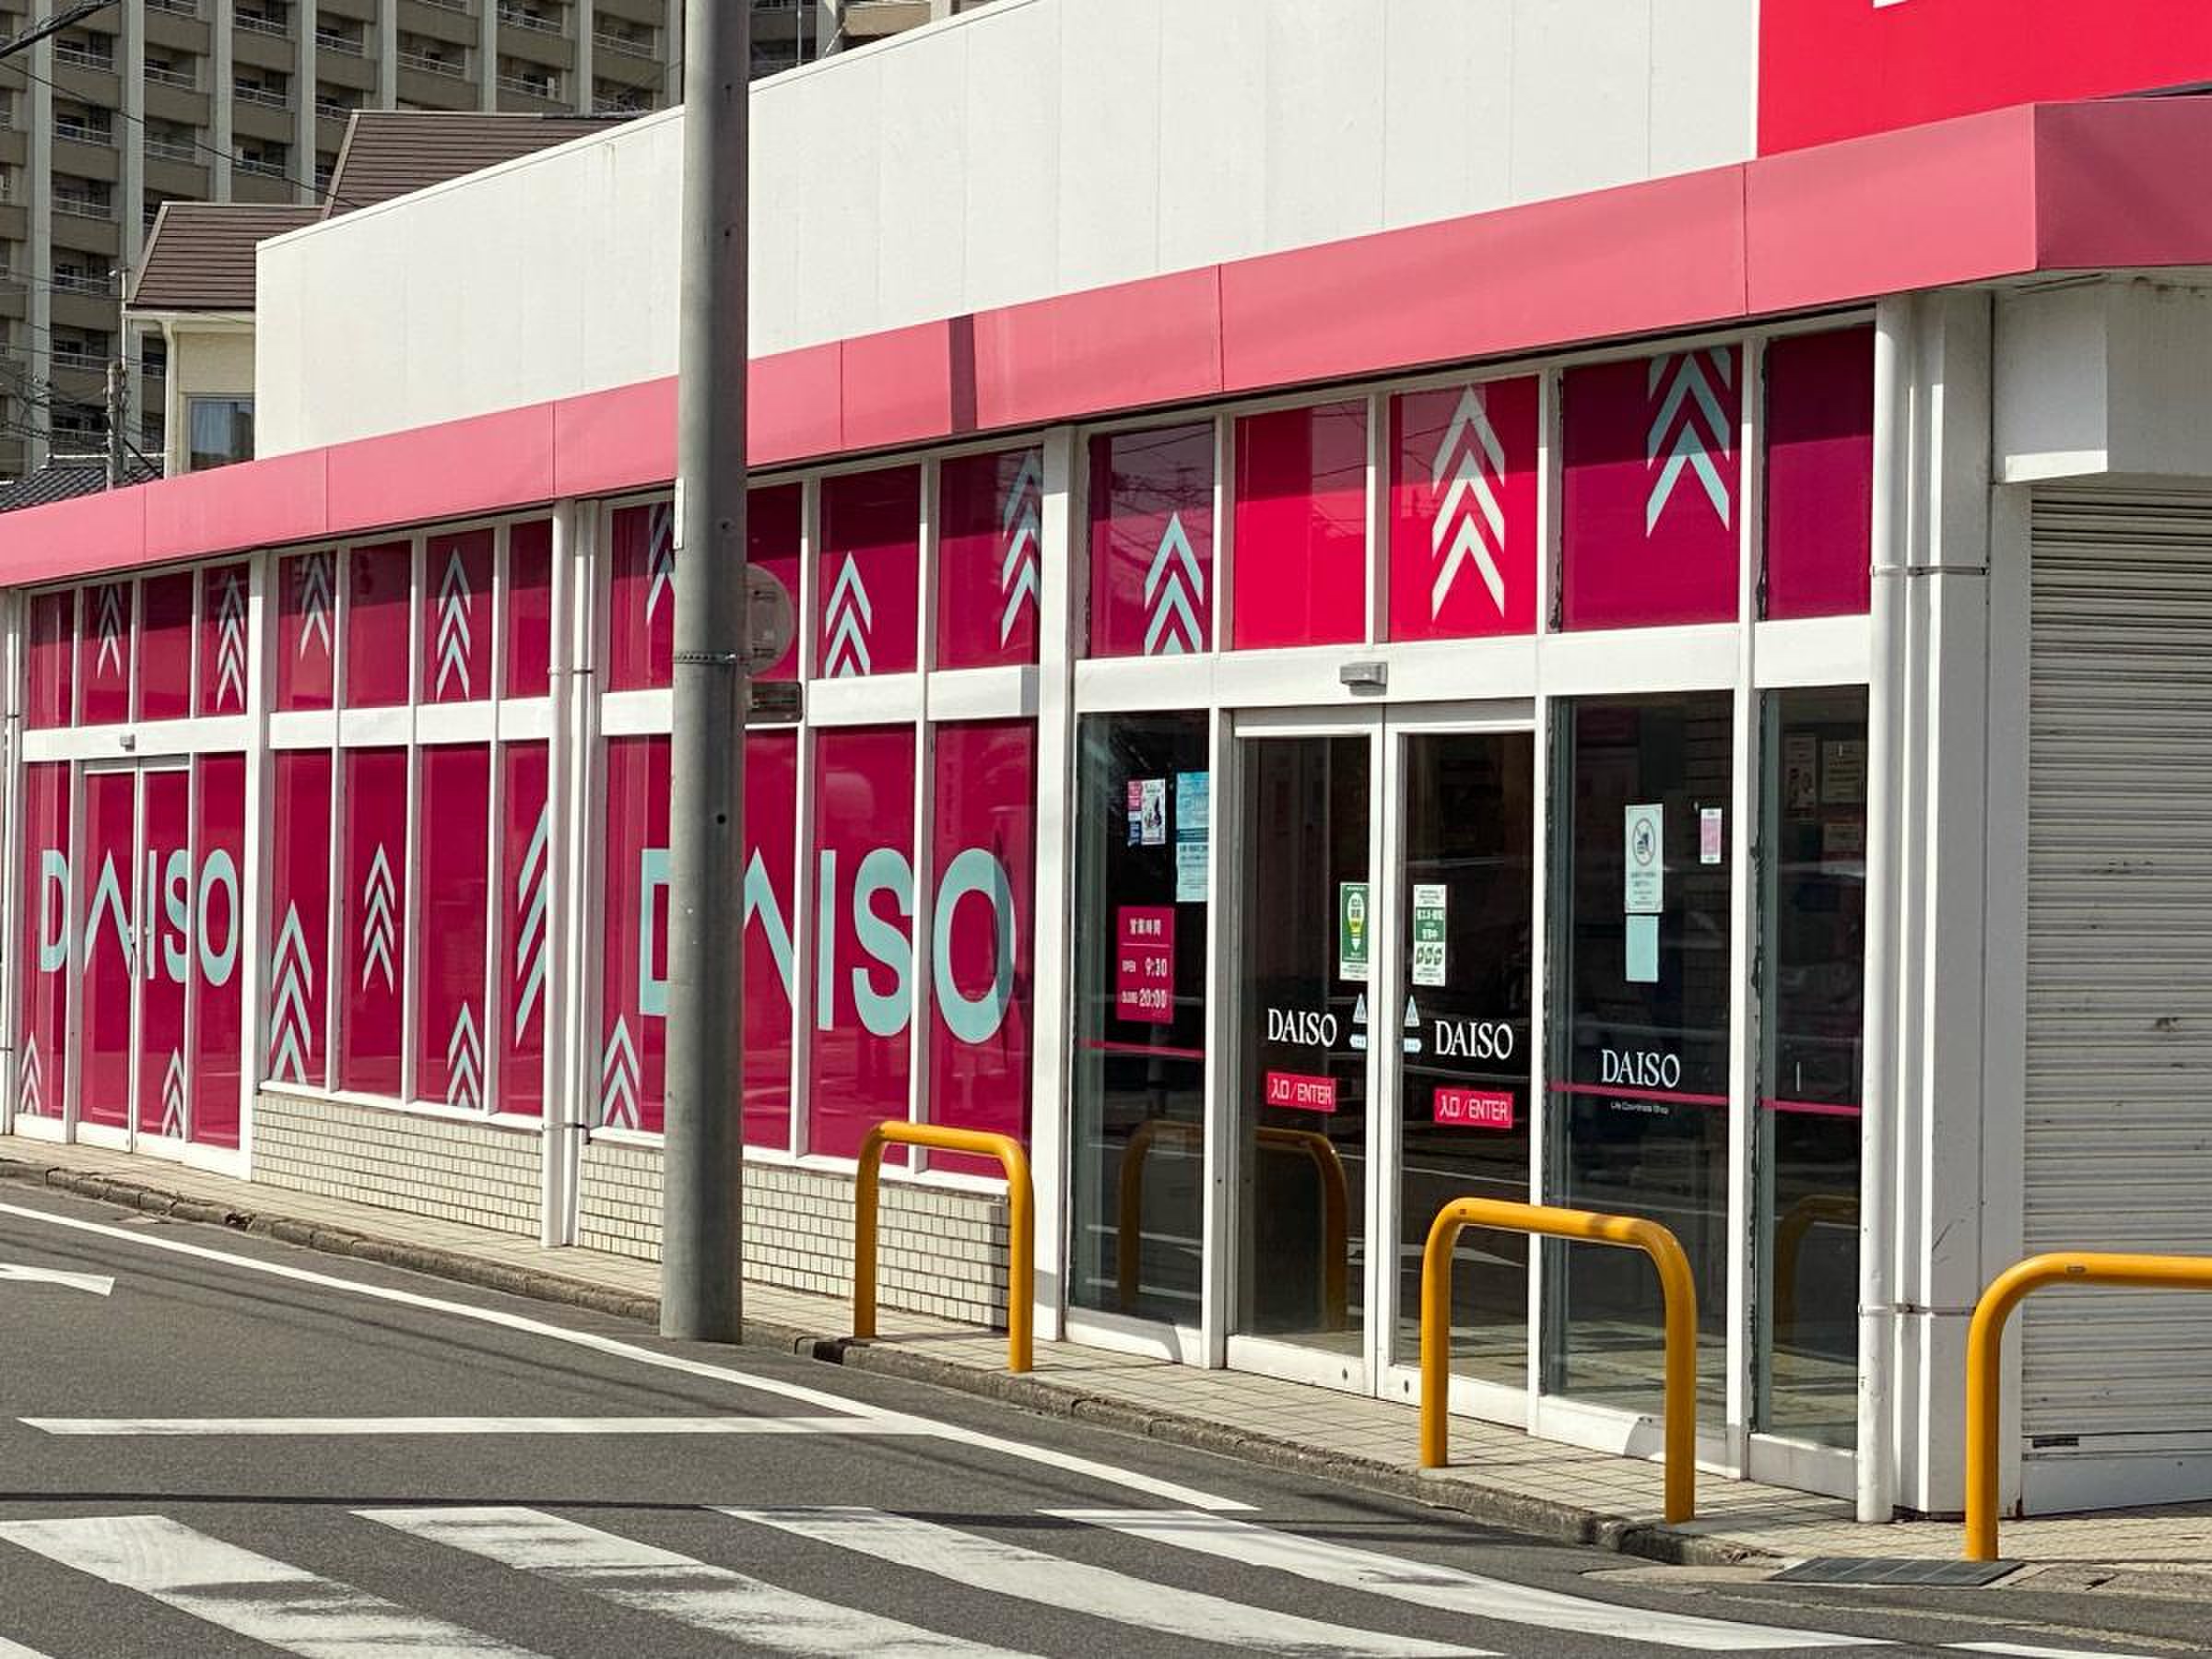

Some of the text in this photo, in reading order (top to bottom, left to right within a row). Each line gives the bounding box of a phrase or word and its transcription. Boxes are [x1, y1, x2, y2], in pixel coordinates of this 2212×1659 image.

[41, 848, 238, 986] DAISO
[1145, 957, 1167, 977] 9:30
[1268, 1008, 1337, 1047] DAISO
[1434, 1020, 1513, 1060] DAISO
[1601, 1049, 1680, 1088] DAISO
